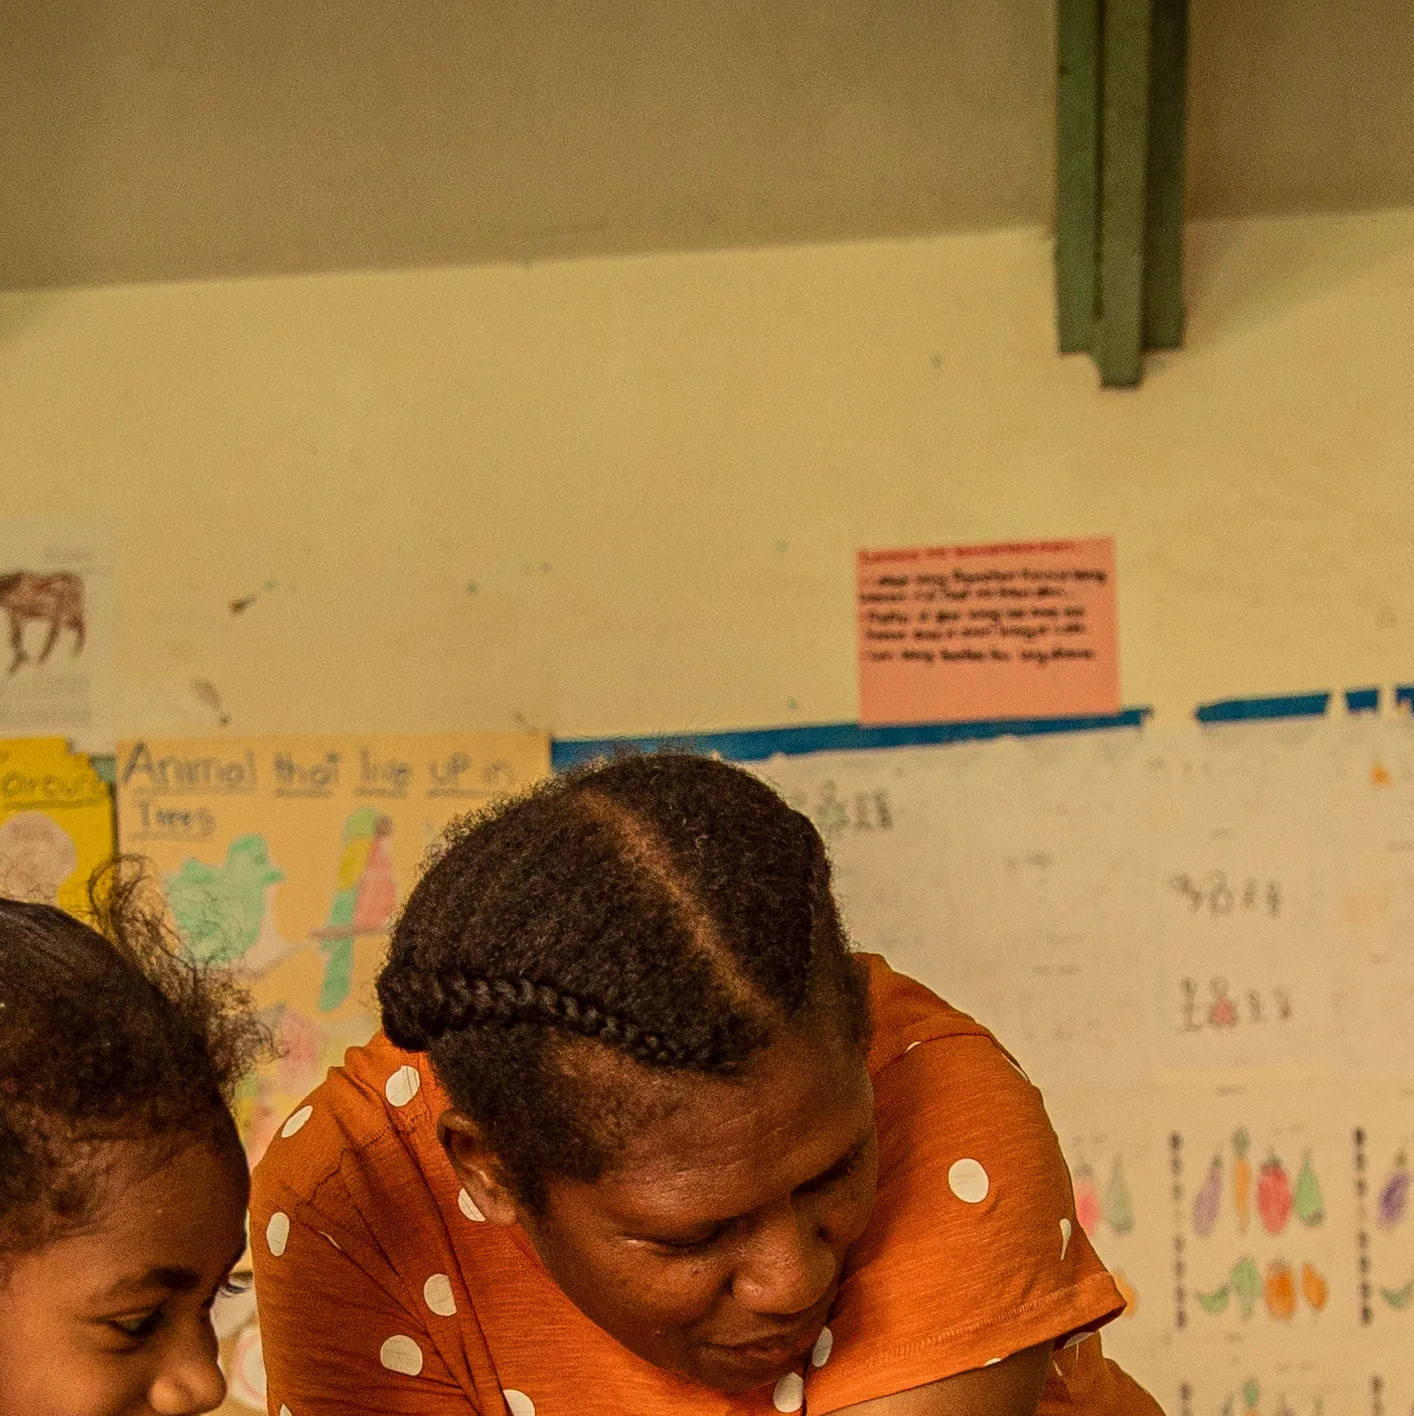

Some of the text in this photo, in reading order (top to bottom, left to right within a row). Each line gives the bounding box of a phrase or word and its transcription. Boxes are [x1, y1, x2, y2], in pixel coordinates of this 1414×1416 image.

[122, 742, 256, 787] Animal
[274, 749, 341, 786] that
[360, 744, 412, 788] live
[136, 800, 216, 838] Trees
